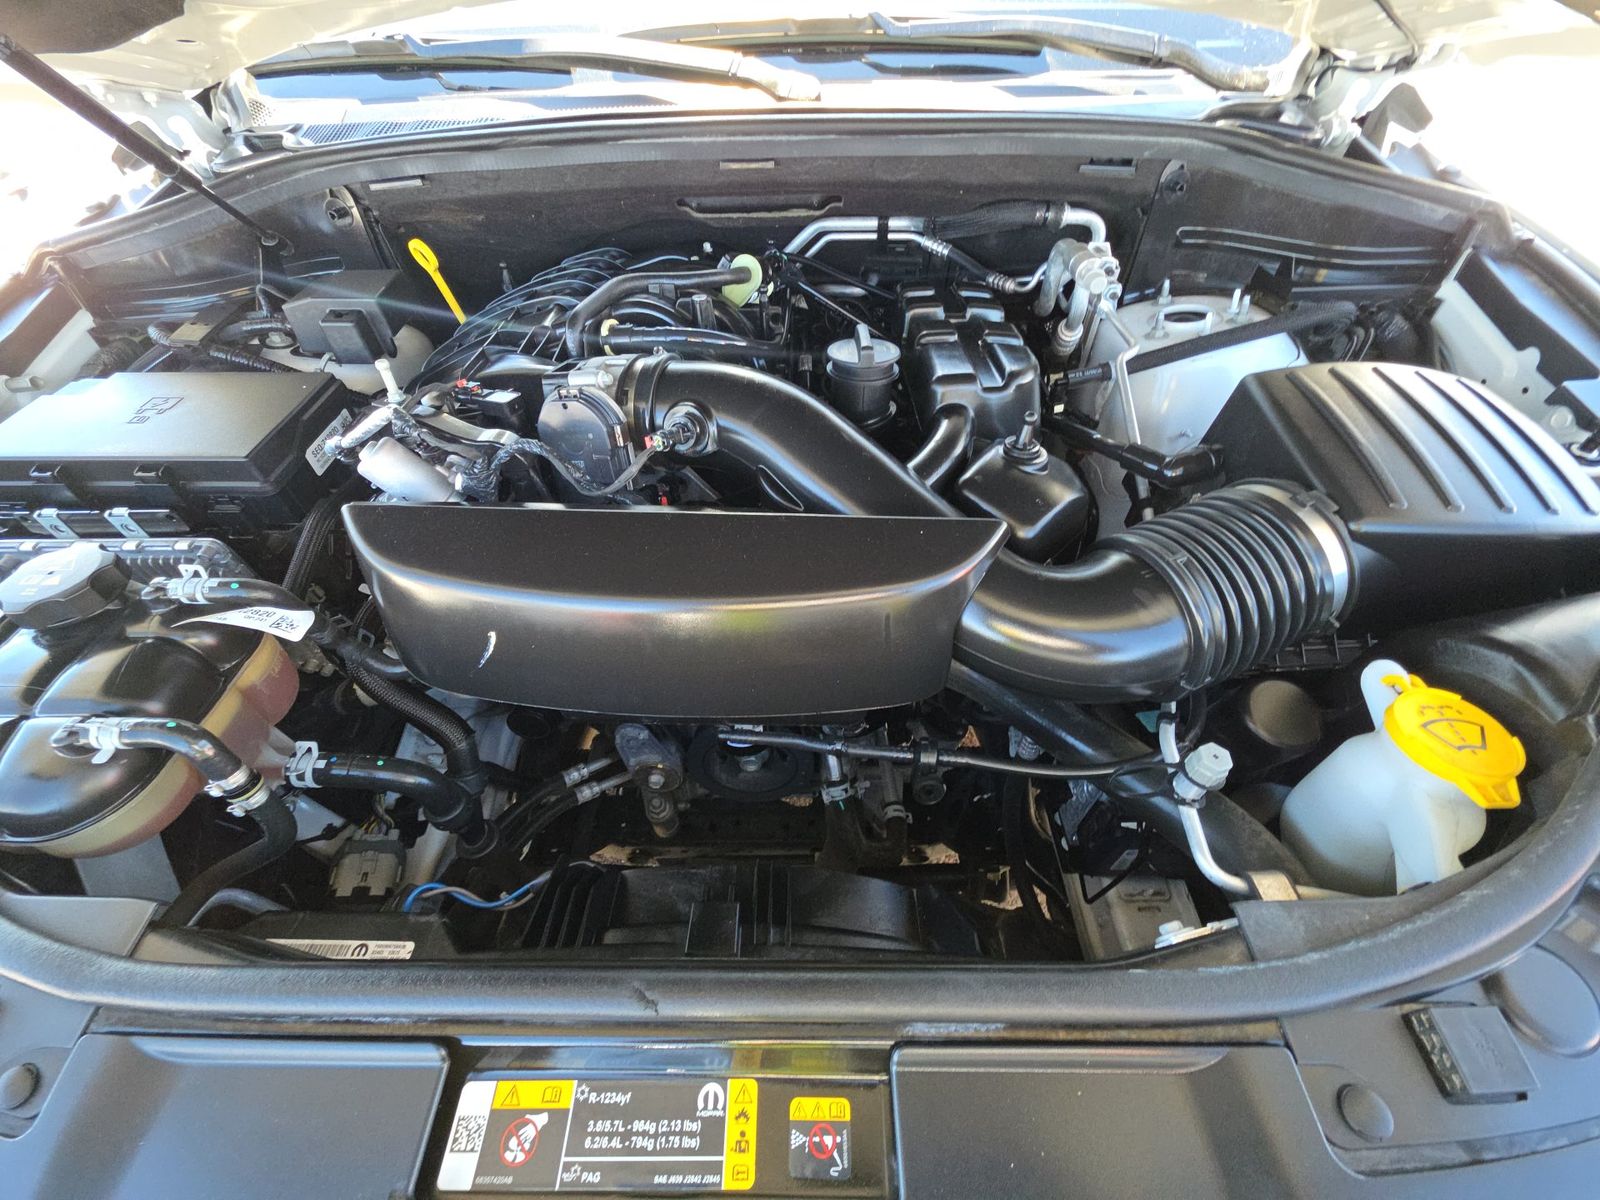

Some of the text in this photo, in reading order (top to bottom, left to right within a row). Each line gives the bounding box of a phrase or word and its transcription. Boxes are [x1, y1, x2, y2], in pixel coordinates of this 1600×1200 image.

[588, 1092, 632, 1106] R-1234yf
[587, 1120, 625, 1132] 3.6/5.7L
[658, 1119, 682, 1133] (2.13
[683, 1119, 701, 1133] lbs)
[585, 1136, 623, 1148] 6.2/6.4L
[631, 1136, 655, 1150] 794g
[656, 1136, 680, 1150] (1.75
[681, 1136, 700, 1150] lbs)
[581, 1171, 601, 1184] PAG
